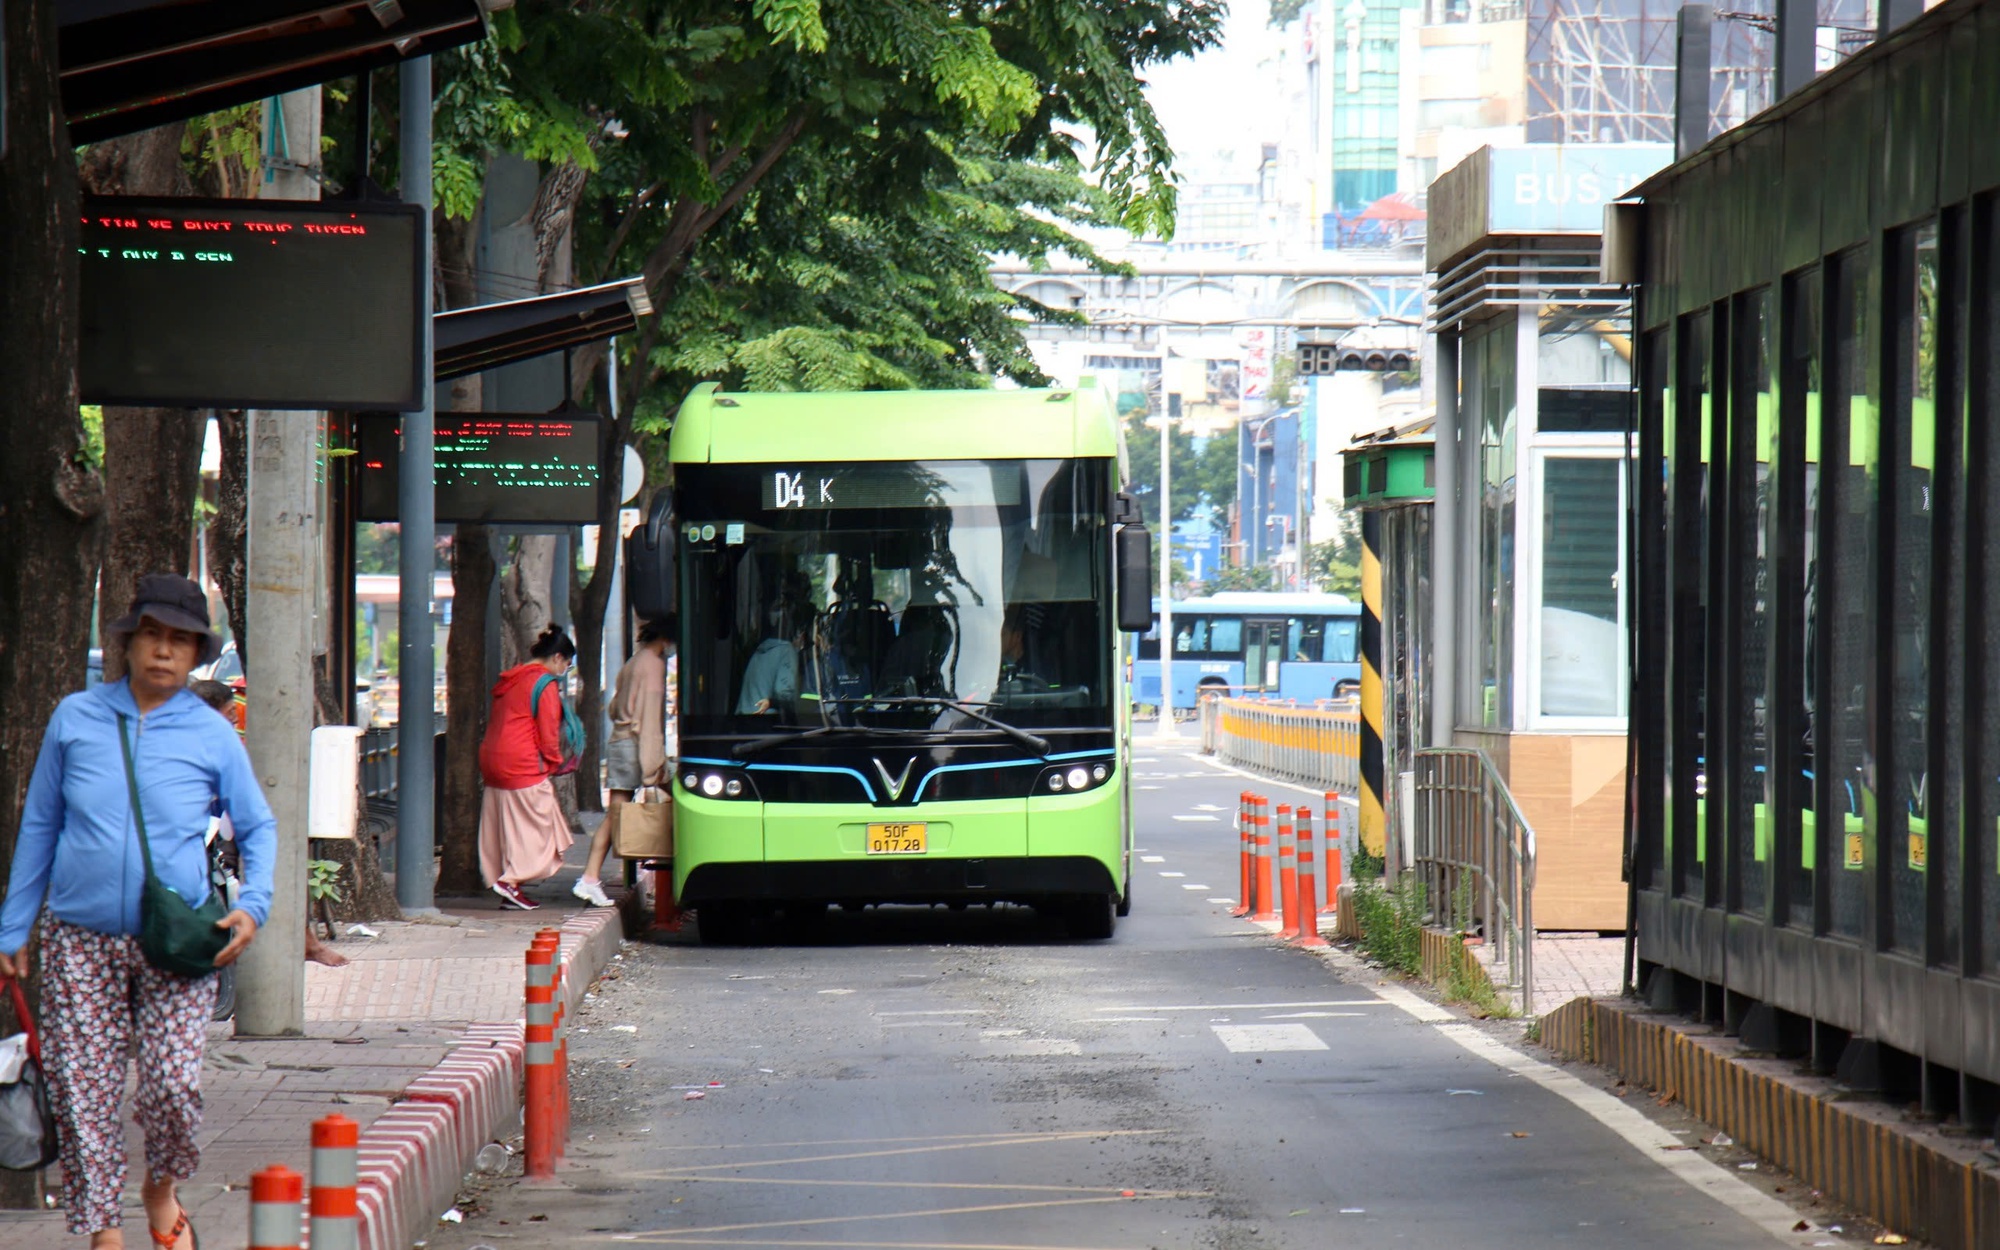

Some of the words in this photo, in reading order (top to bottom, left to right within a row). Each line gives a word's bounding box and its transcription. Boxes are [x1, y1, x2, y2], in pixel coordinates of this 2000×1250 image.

[1515, 173, 1601, 205] BUS
[775, 471, 806, 508] D4
[820, 478, 834, 503] K
[884, 825, 910, 838] 50F
[873, 839, 921, 852] 017.28
